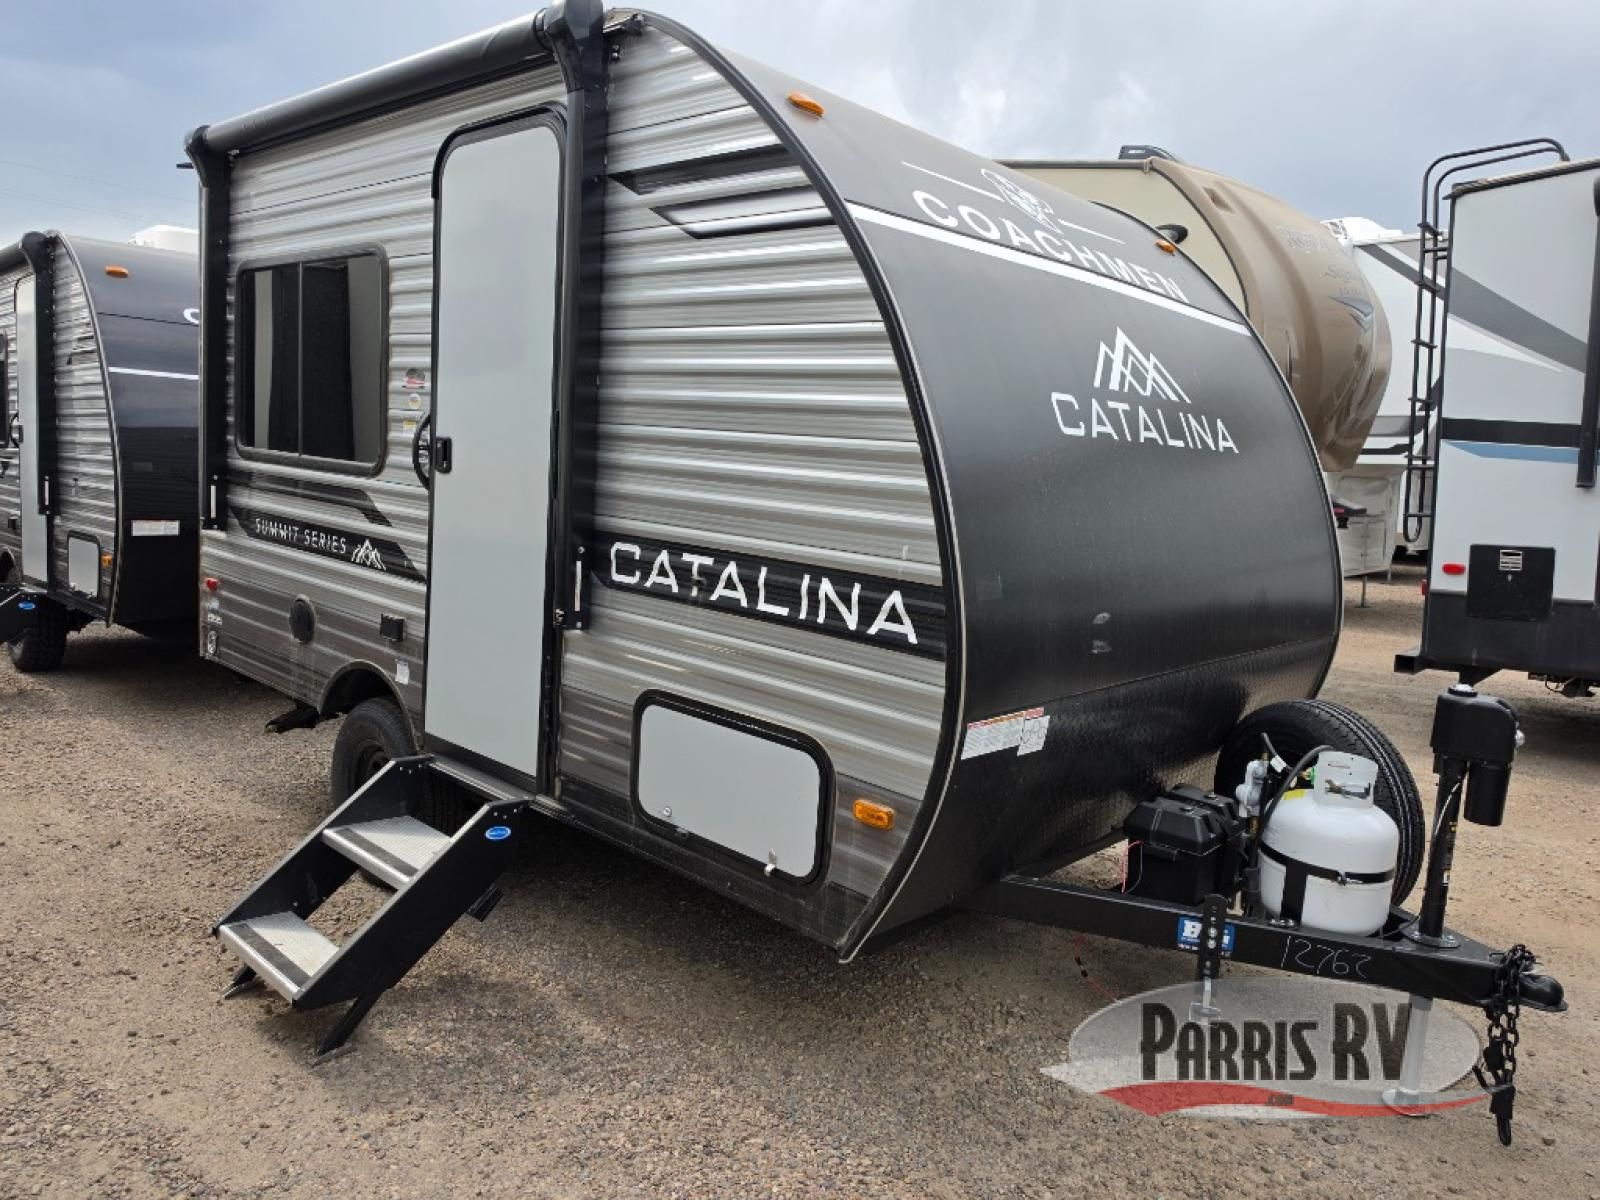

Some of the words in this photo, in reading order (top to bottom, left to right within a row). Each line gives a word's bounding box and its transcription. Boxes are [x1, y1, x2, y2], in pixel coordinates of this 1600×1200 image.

[912, 190, 1189, 303] COACHMEN
[1051, 391, 1239, 454] CATALINA
[255, 518, 299, 542] SUMMIT
[304, 529, 346, 554] SERIES
[610, 541, 918, 645] CATALINA
